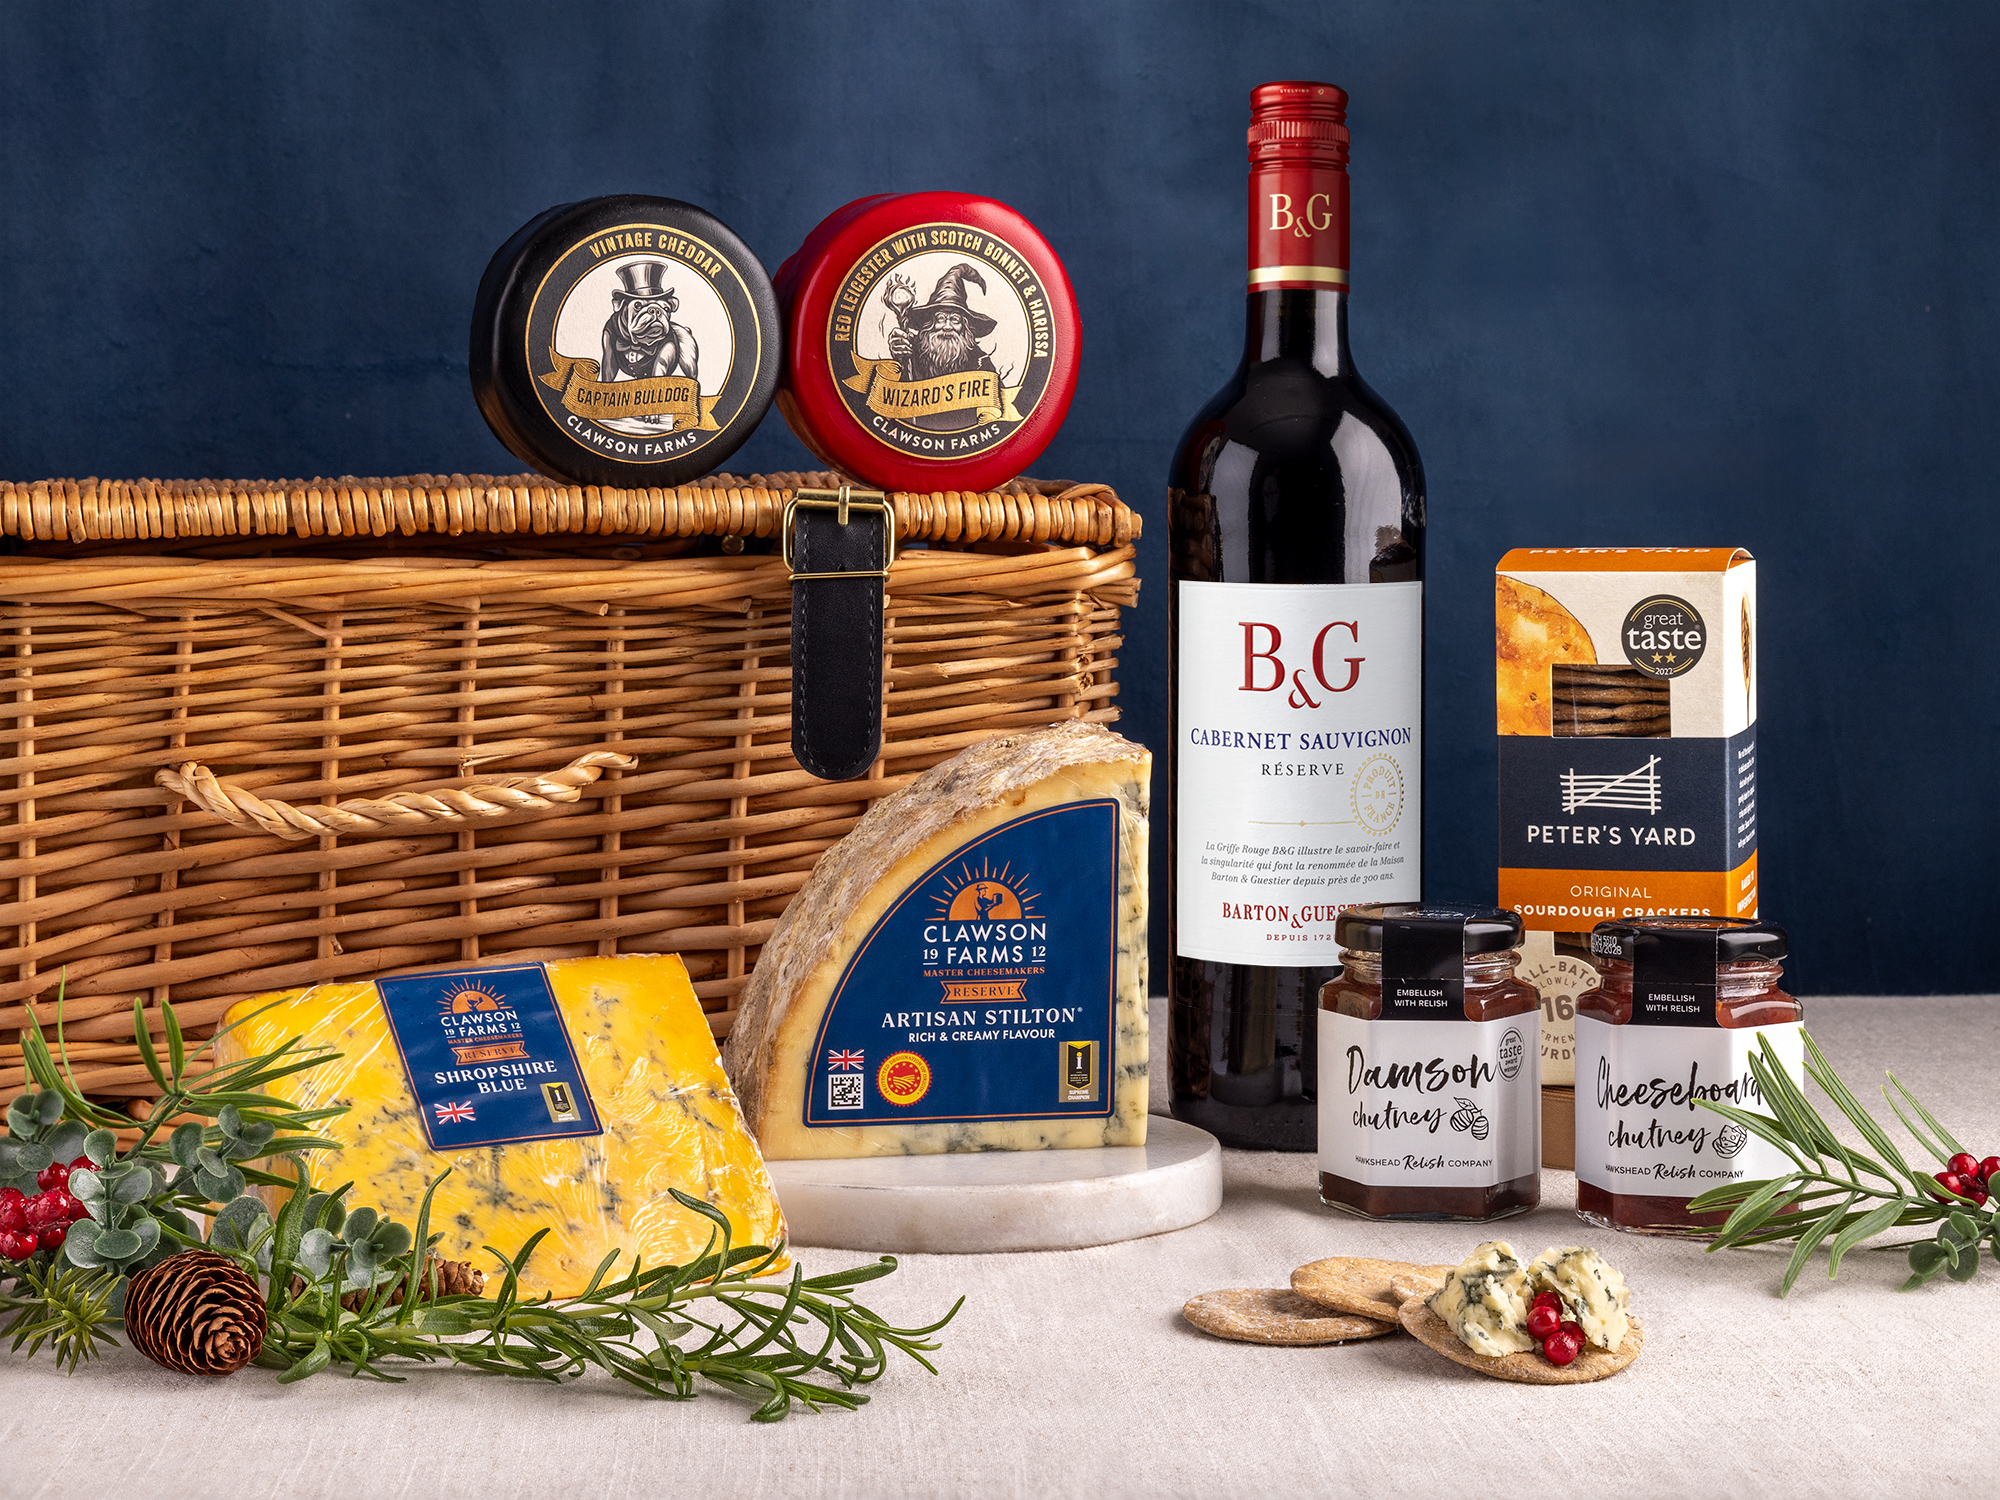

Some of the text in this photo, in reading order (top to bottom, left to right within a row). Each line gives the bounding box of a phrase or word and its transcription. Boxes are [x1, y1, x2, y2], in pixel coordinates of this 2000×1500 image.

[1269, 193, 1333, 238] B&G
[590, 233, 722, 278] VINTAGE CHEDDAR
[834, 230, 1048, 359] RED LEICESTER WITH SCOTCH BONNET & HARISSA
[577, 387, 689, 407] CAPTAIN BULLDOG
[883, 379, 991, 407] WIZARD'S FIRE
[567, 415, 696, 455] CLAWSON FARMS
[873, 415, 1001, 450] CLAWSON FARMS
[1644, 612, 1683, 629] great
[1626, 627, 1702, 650] taste
[1238, 621, 1365, 709] B&G
[1655, 667, 1673, 676] 2022
[1190, 727, 1411, 750] CABERNET SAUVIGNON
[1261, 762, 1344, 776] RÉSERVE
[1363, 765, 1396, 790] PRODUIT
[1375, 790, 1385, 800] DE
[1364, 802, 1395, 823] FRANCE
[1527, 825, 1696, 846] PETER'S YARD
[1206, 841, 1400, 856] La Griffe Rouge B&G illustre le savoir-faire et
[1201, 855, 1404, 871] la singularité qui font la renommée de la Maison
[1211, 872, 1394, 887] Barton & Guestier depuis près de 300 ans.
[1570, 885, 1652, 899] ORIGINAL
[1513, 904, 1615, 917] SOURDOUGH
[923, 923, 1046, 943] CLAWSON
[1266, 933, 1336, 942] DEPUIS 172
[923, 946, 1046, 964] 19 FARMS 12
[923, 967, 1045, 977] MASTER CHEESEMAKERS
[953, 986, 1015, 997] RESERVE
[1397, 989, 1443, 997] EMBELLISH
[1648, 993, 1695, 1002] EMBELLISH
[1394, 999, 1448, 1008] WITH RELISH
[1542, 995, 1574, 1022] 16
[1645, 1004, 1700, 1013] WITH RELISH
[440, 1010, 518, 1027] CLAWSON
[881, 1011, 977, 1028] ARTISAN
[444, 1022, 521, 1037] 19 FARMS 12
[908, 1029, 1056, 1043] RICH & CREAMY FLAVOUR
[447, 1033, 524, 1045] MASTER CHEESEMAKERS
[464, 1046, 517, 1060] RESERVE
[1499, 1045, 1522, 1059] taste
[434, 1060, 558, 1085] SHROPSHIRE
[1347, 1045, 1497, 1094] Damson
[477, 1078, 527, 1094] BLUE
[1353, 1100, 1447, 1134] chutney
[1608, 1118, 1711, 1154] chutney
[1355, 1154, 1492, 1170] HAWKSHEAD Relish COMPANY
[1605, 1163, 1744, 1180] HAWKSHEAD Relish COMPANY
